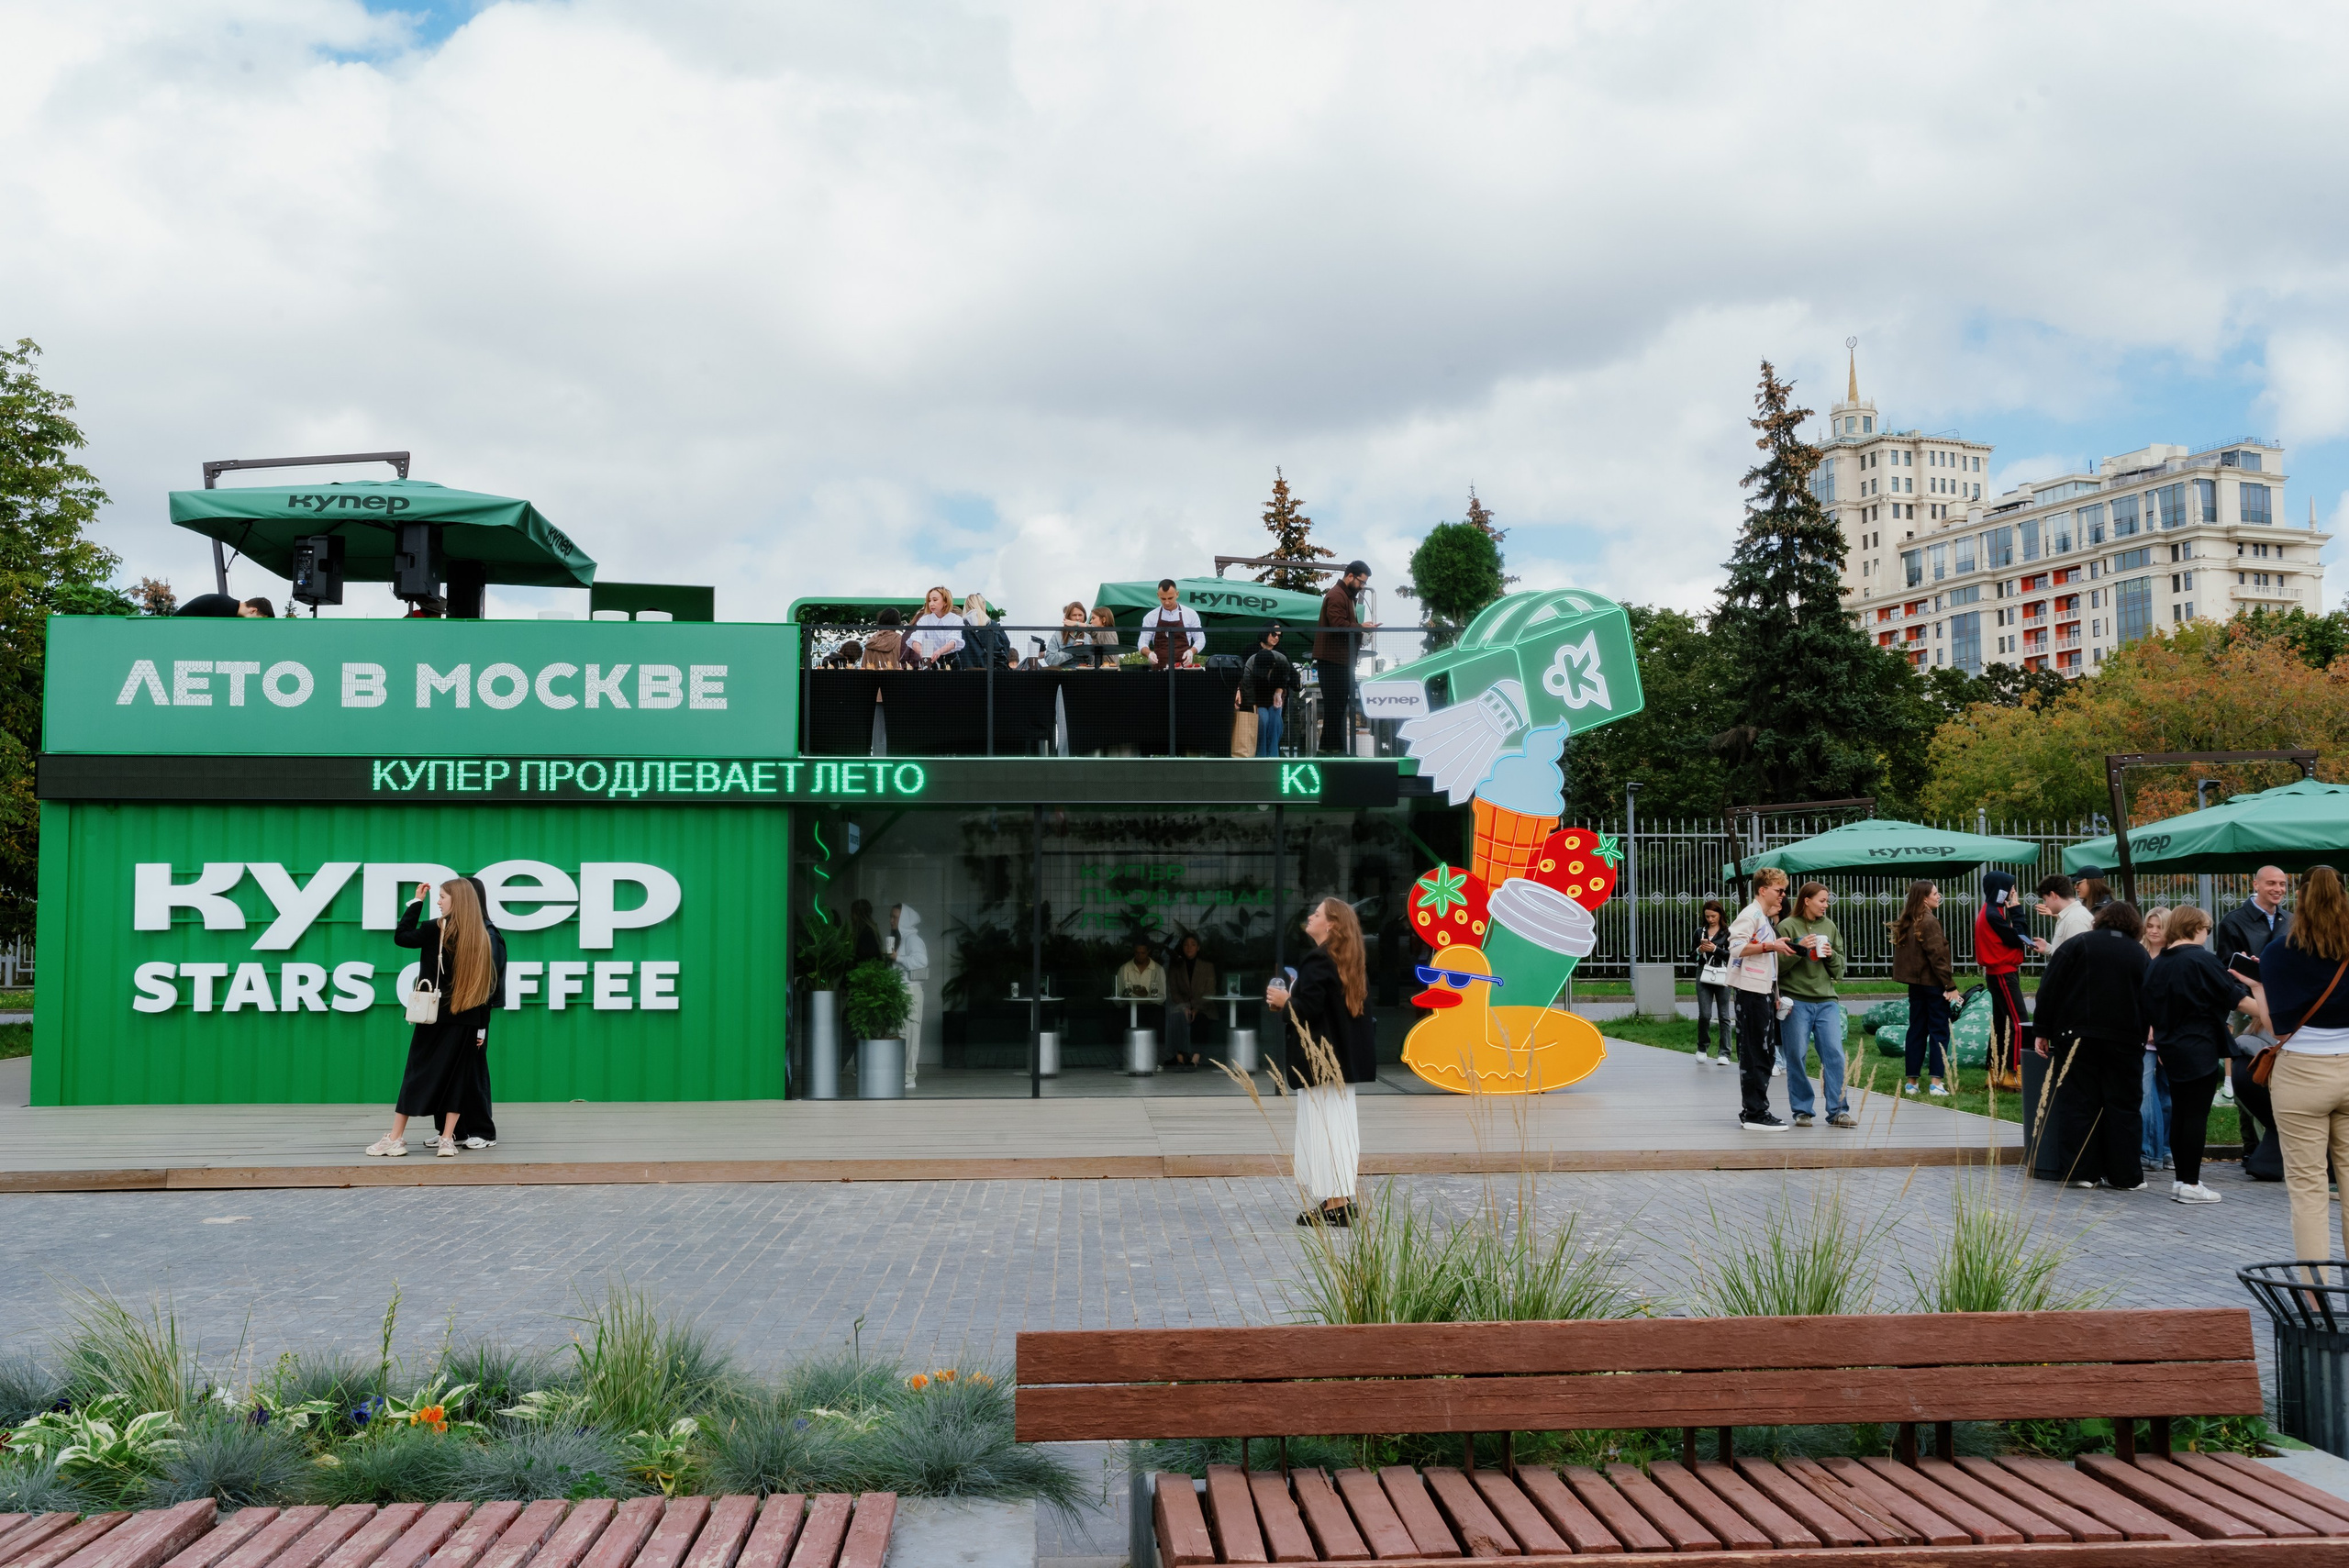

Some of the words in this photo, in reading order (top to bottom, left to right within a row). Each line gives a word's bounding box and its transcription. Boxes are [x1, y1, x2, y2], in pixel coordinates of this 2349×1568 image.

[288, 493, 410, 516] купер
[545, 526, 573, 560] купер
[1189, 591, 1278, 612] купер
[116, 660, 315, 709] ЛЕТО
[341, 662, 388, 709] В
[416, 662, 729, 711] МОСКВЕ
[1365, 695, 1420, 707] купер
[373, 761, 511, 793] КУПЕР
[520, 761, 805, 798] ПРОДЛЕВАЕТ
[811, 762, 926, 795] ЛЕТО
[1867, 845, 1956, 860] купер
[1079, 862, 1186, 881] КУПЕР
[134, 859, 683, 951] купер
[133, 961, 376, 1014] STARS
[395, 961, 681, 1014] FFEE
